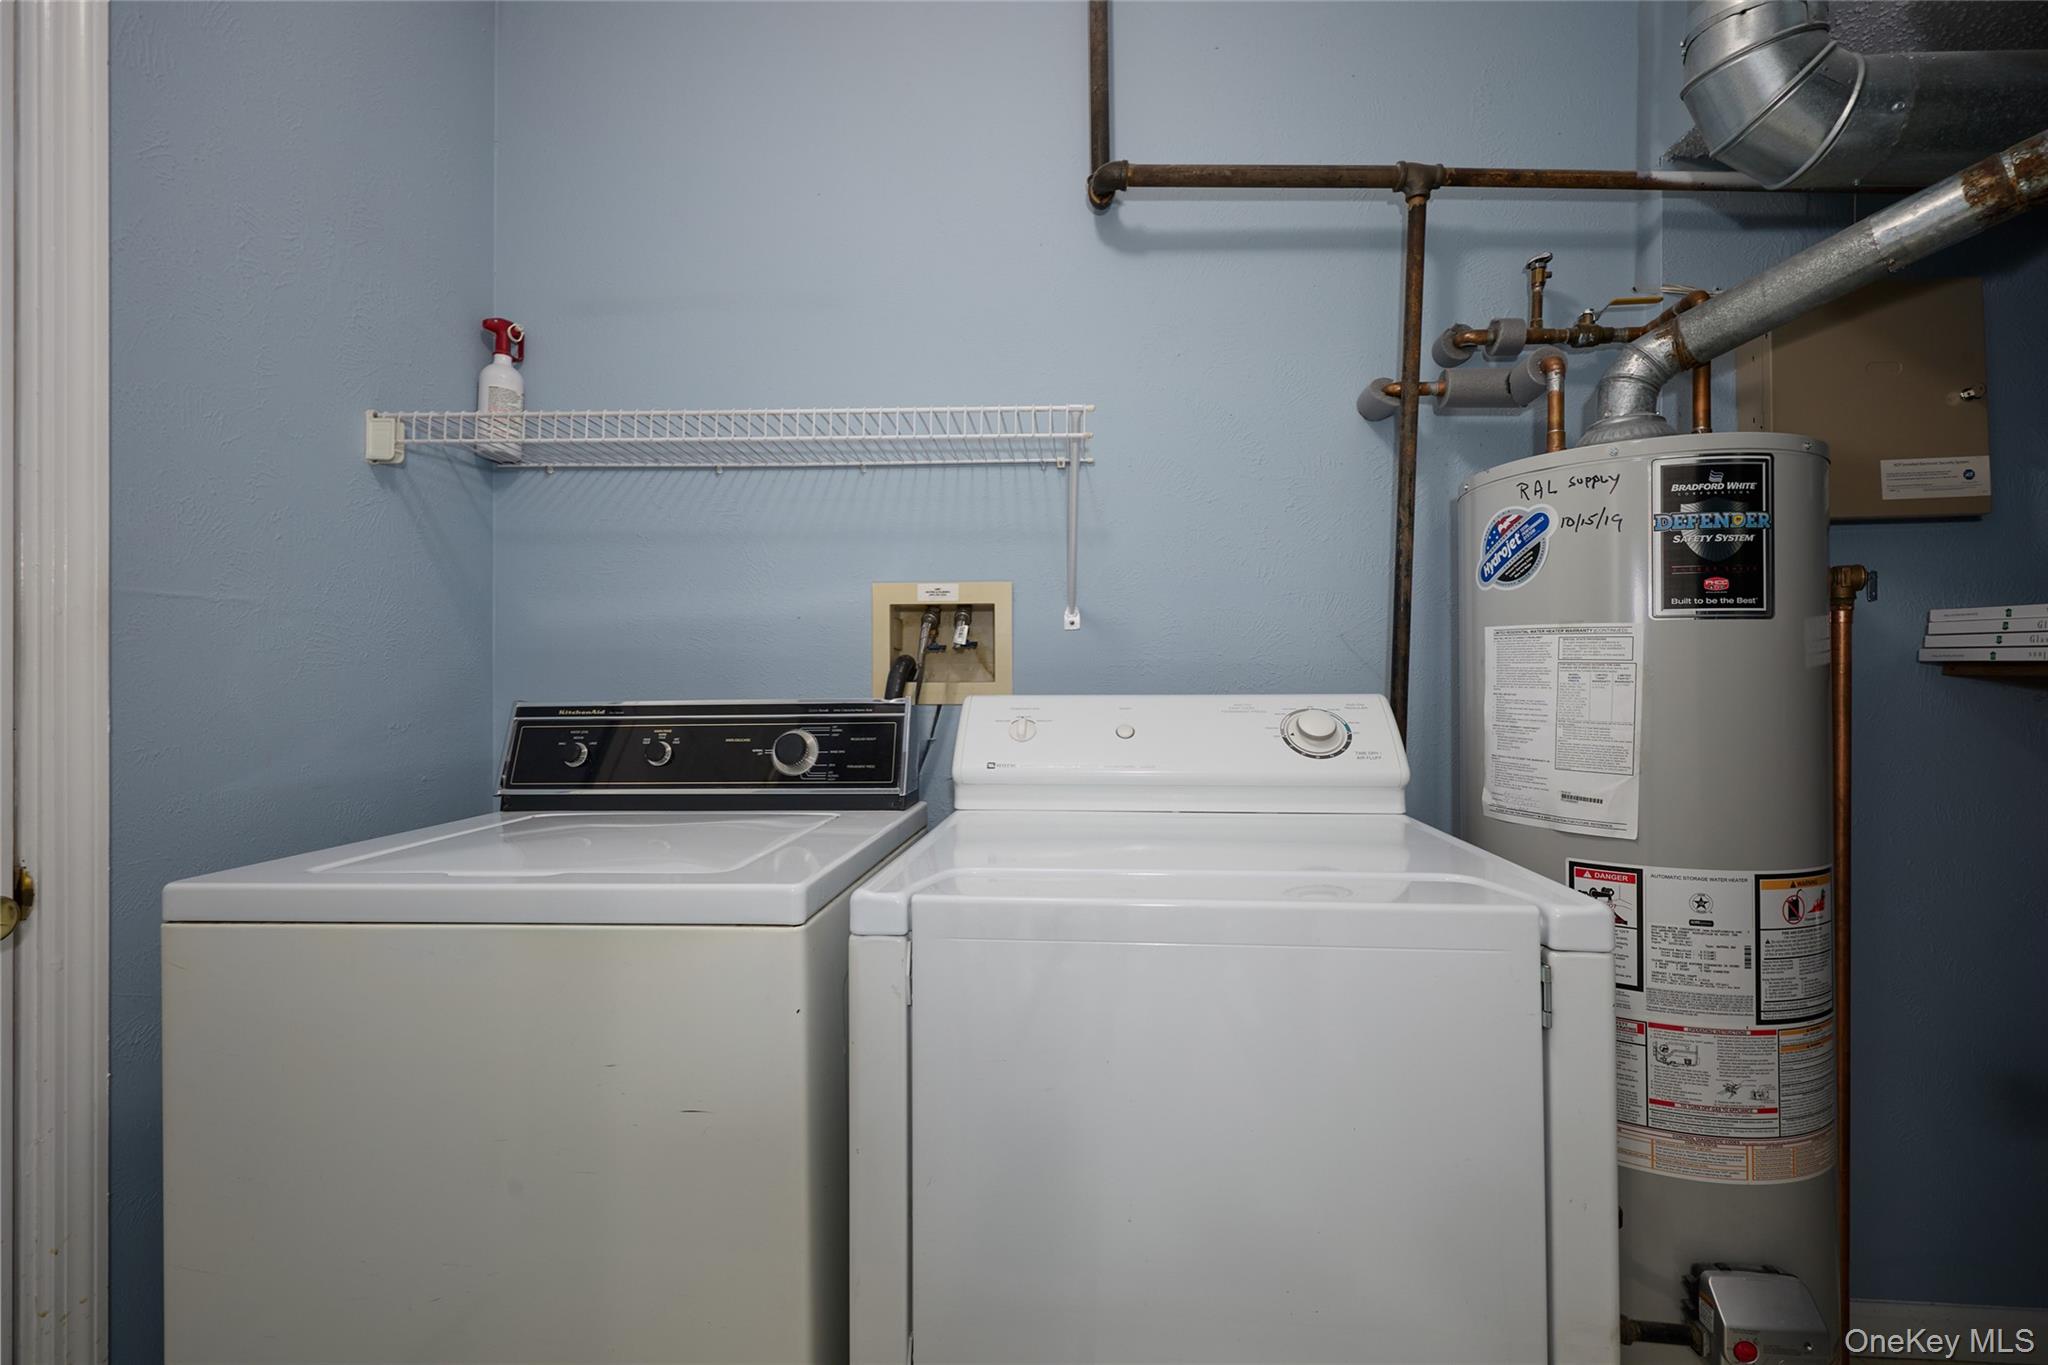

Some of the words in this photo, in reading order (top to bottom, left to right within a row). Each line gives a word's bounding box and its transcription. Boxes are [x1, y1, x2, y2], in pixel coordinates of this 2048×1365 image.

[1517, 480, 1558, 501] RAL
[1671, 482, 1725, 492] BRADFORD
[1726, 481, 1758, 490] WHITE
[1560, 507, 1623, 532] 10/15/19
[1654, 512, 1771, 532] DEFENDER
[1672, 534, 1713, 543] SAFETY
[1715, 533, 1756, 542] SYSTEM
[1484, 532, 1522, 578] Hydrojet
[1594, 872, 1629, 882] DANGER
